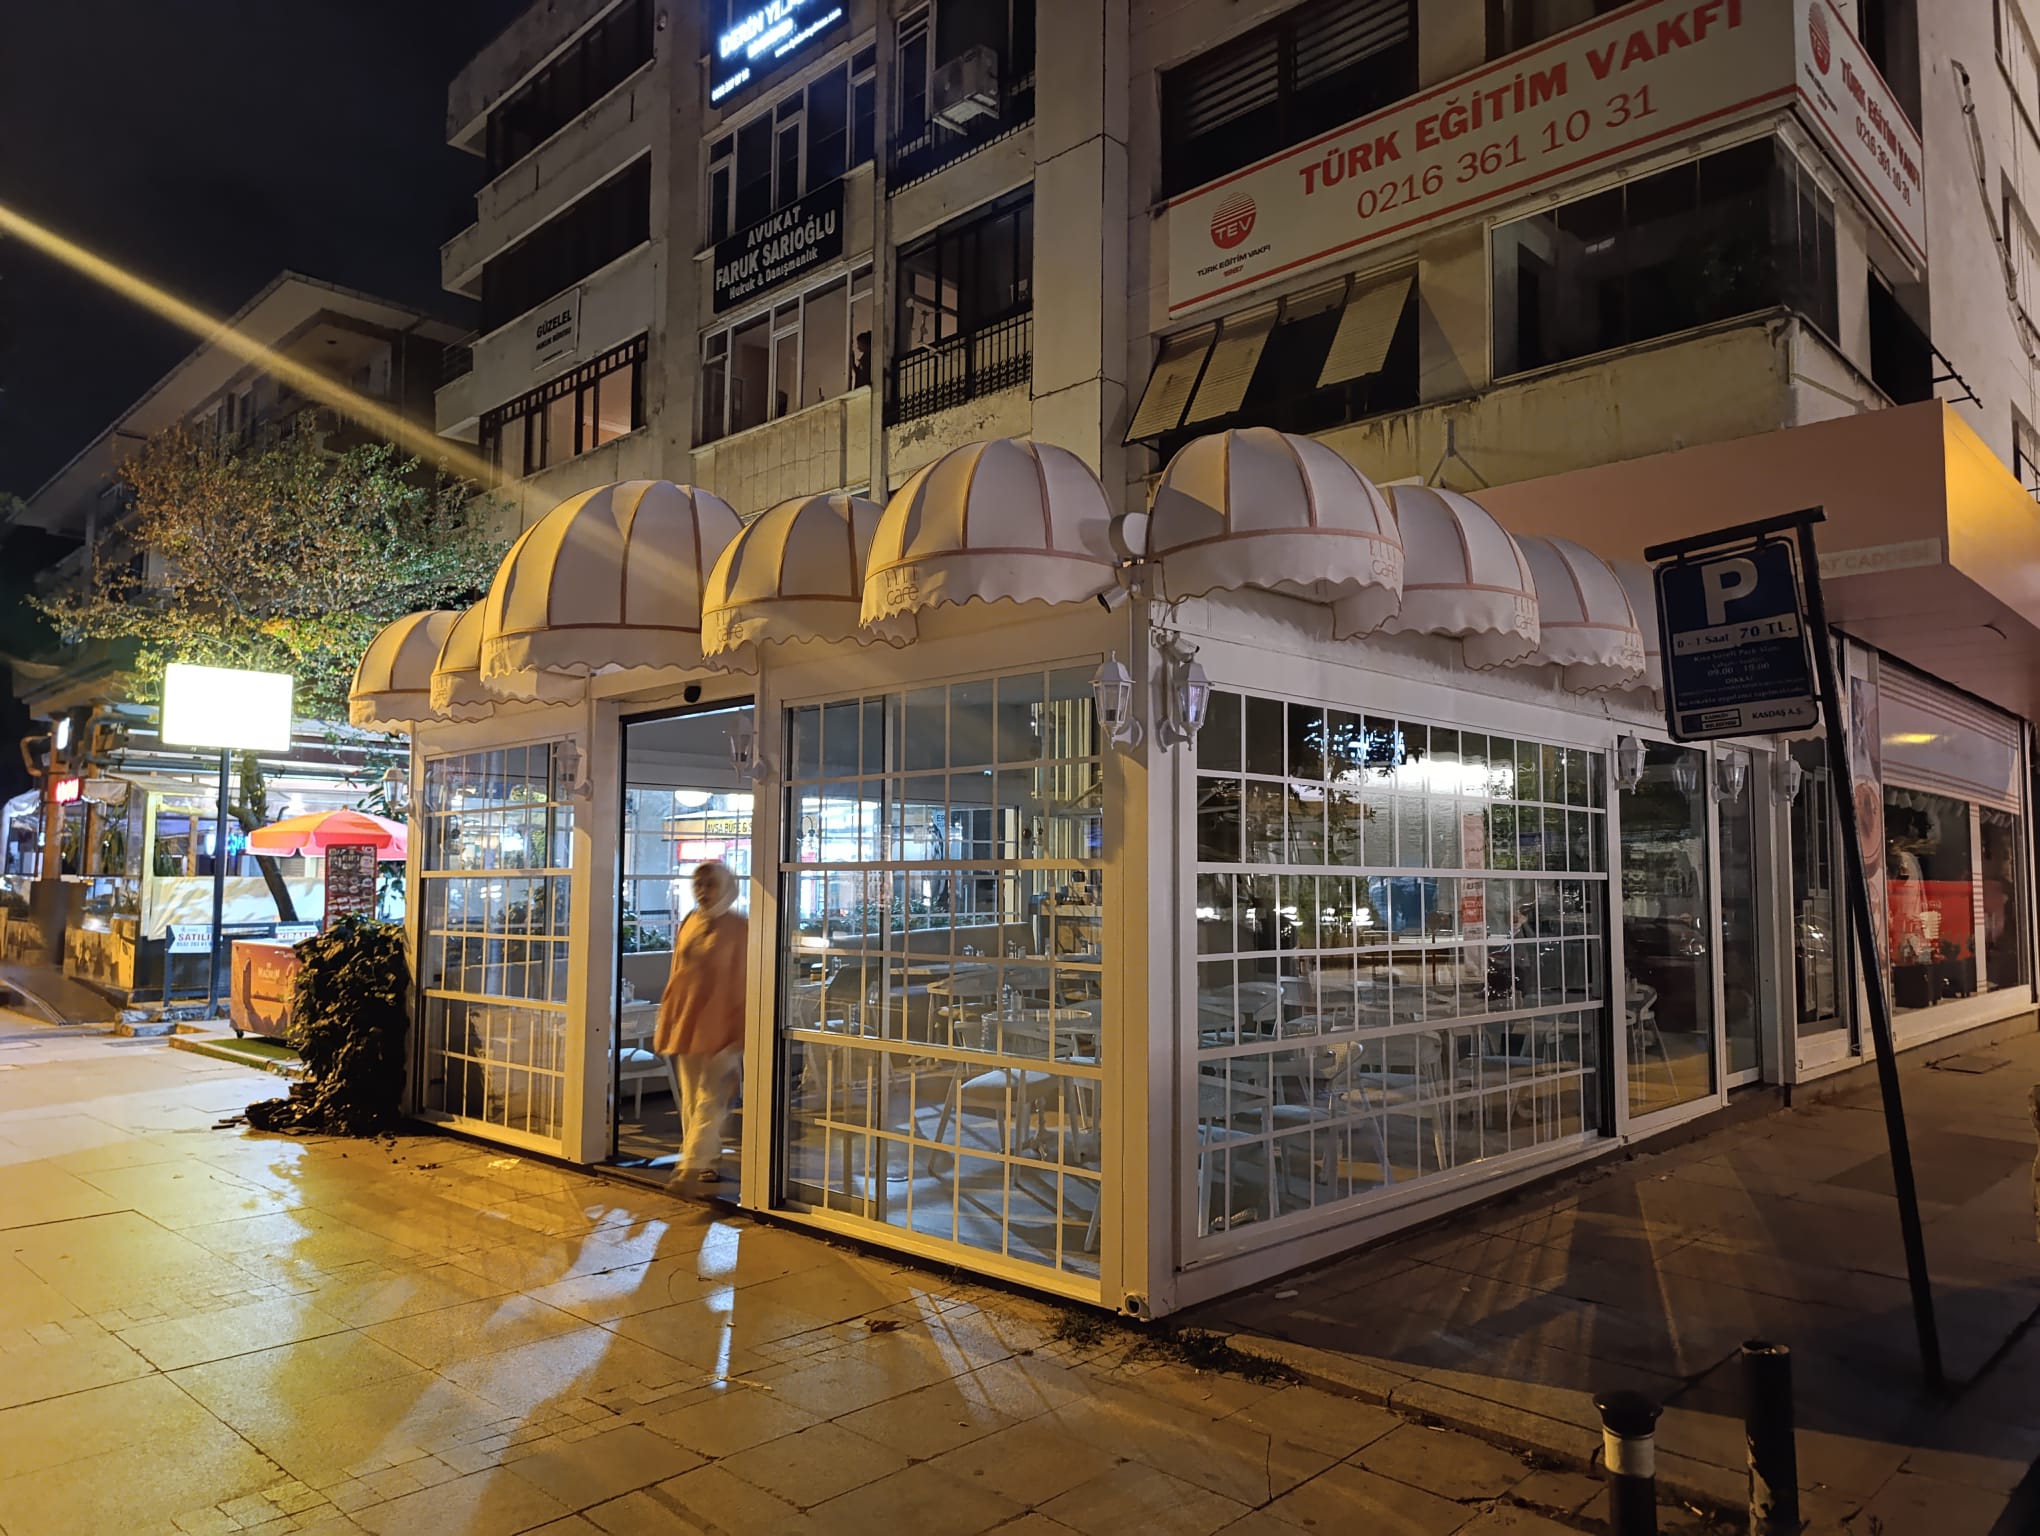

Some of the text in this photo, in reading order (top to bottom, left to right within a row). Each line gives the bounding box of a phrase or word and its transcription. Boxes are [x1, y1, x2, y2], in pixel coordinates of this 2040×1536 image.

[1299, 0, 1743, 195] TÜRK EĞİTİM VAKFI
[1357, 85, 1659, 219] 0216 361 10 31
[716, 209, 836, 291] FARUK SARIOĞLU
[747, 205, 800, 248] AVUKAT
[1215, 216, 1252, 240] TEV
[729, 246, 818, 299] Hukuk & Danışmanlık
[1702, 558, 1758, 625] P
[1705, 634, 1729, 645] Saat
[1739, 626, 1760, 639] 70
[1766, 622, 1793, 635] TL.
[1752, 709, 1786, 720] KASDAŞ
[178, 933, 210, 941] SATILI
